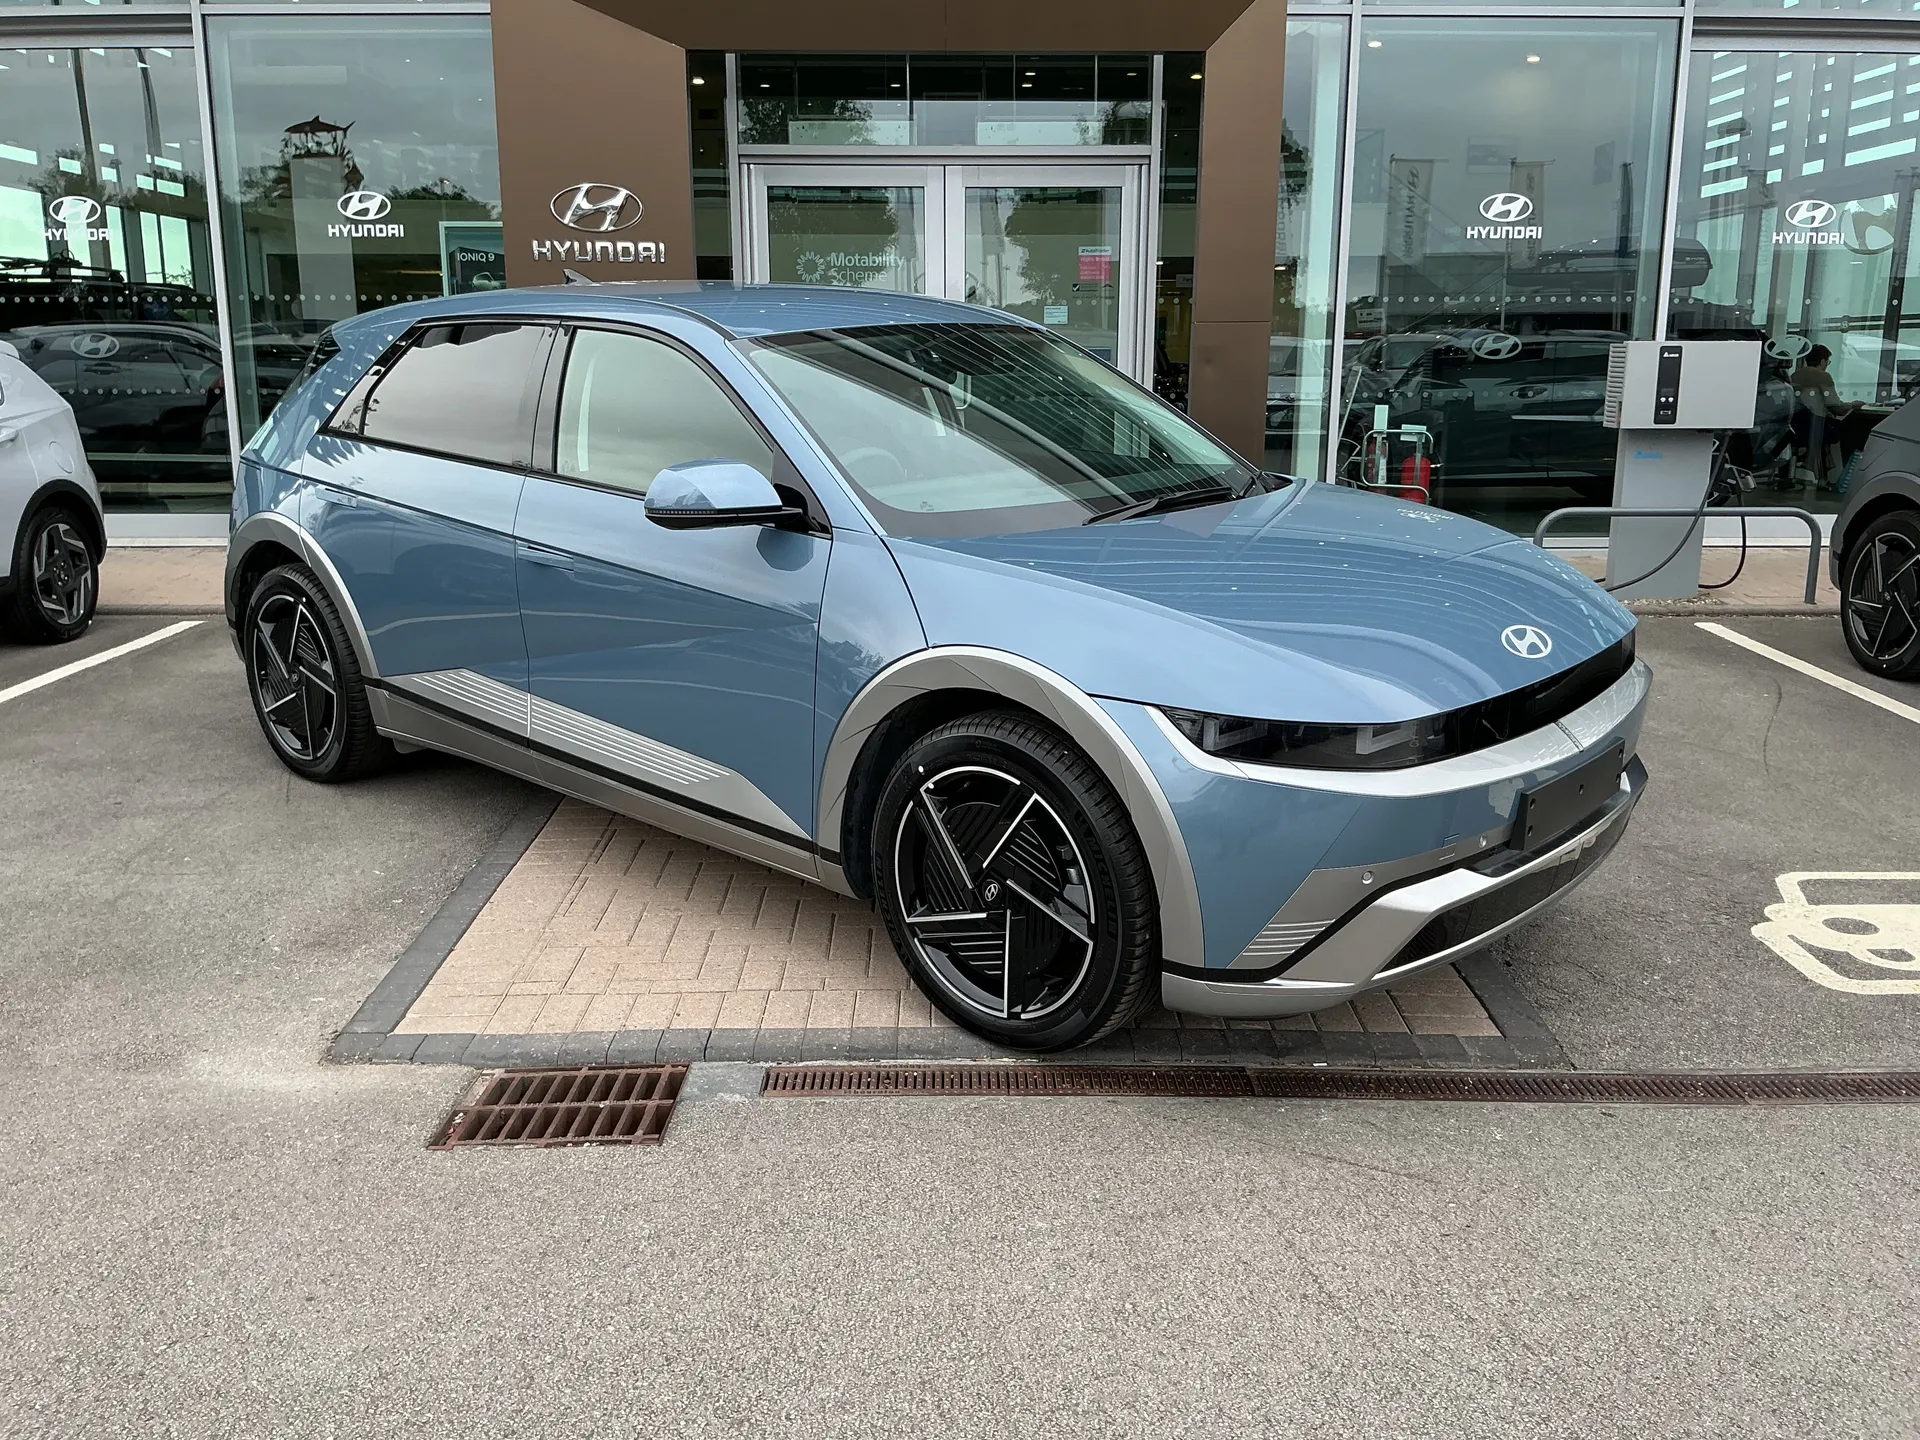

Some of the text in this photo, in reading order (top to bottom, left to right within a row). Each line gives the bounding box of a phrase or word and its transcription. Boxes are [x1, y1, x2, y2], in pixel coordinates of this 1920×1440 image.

[45, 228, 110, 241] HYDA
[327, 223, 405, 238] HYUNDAI
[1466, 225, 1543, 240] HYUNDAI
[1772, 231, 1845, 245] HYUNDAI
[457, 252, 495, 263] IONIQ 9
[532, 239, 666, 263] HYUNDAI
[830, 252, 904, 271] Motability
[831, 268, 888, 282] Scheme
[1086, 836, 1117, 936] MICHELIN
